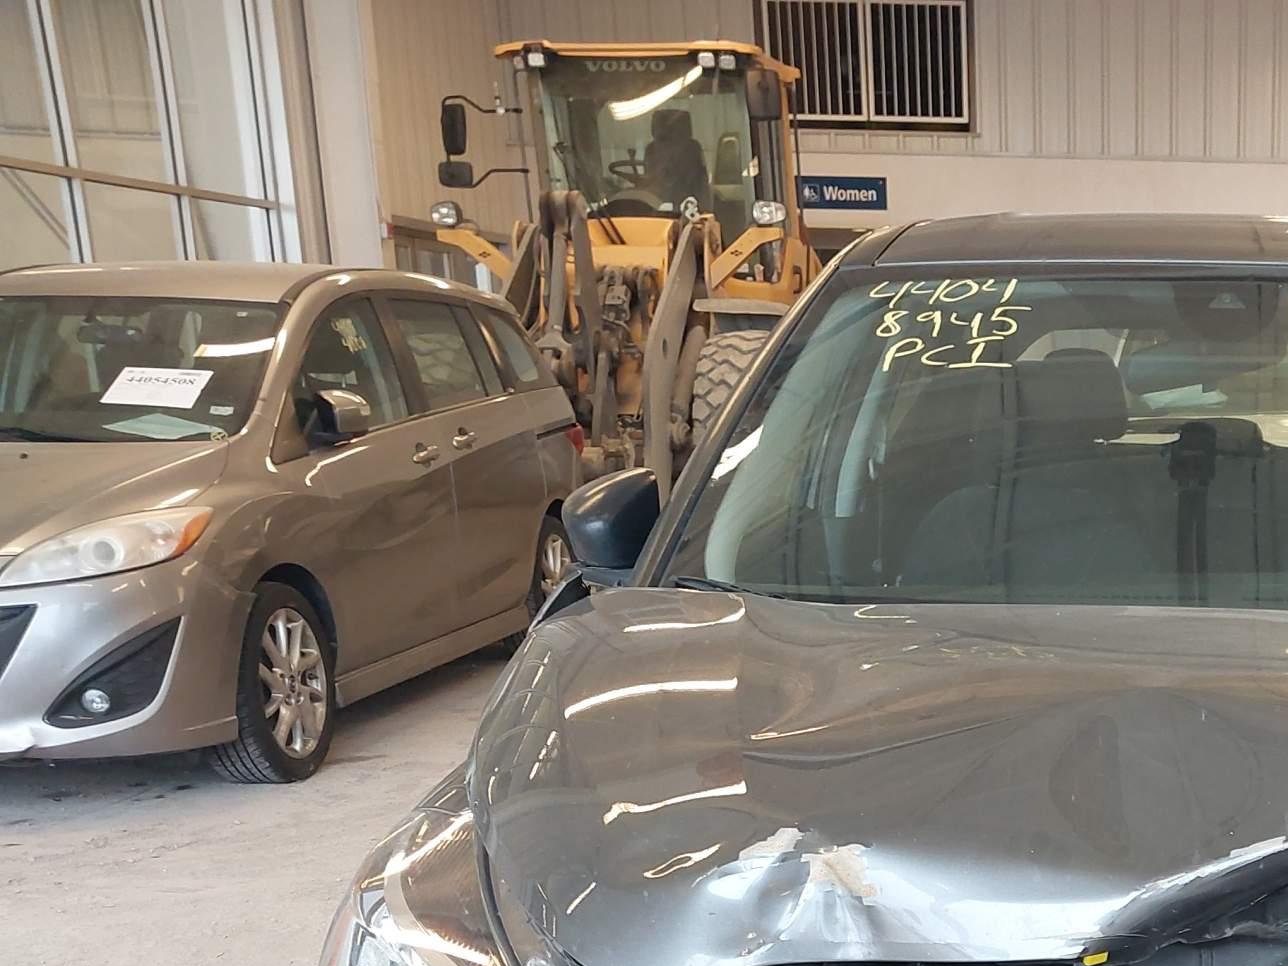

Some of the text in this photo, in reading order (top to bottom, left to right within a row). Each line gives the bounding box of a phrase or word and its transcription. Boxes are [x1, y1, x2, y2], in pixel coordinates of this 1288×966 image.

[584, 60, 666, 72] VOLVO
[823, 185, 878, 201] Women
[869, 278, 1018, 308] 4404
[875, 306, 1032, 337] 8945
[882, 336, 1013, 372] PCI
